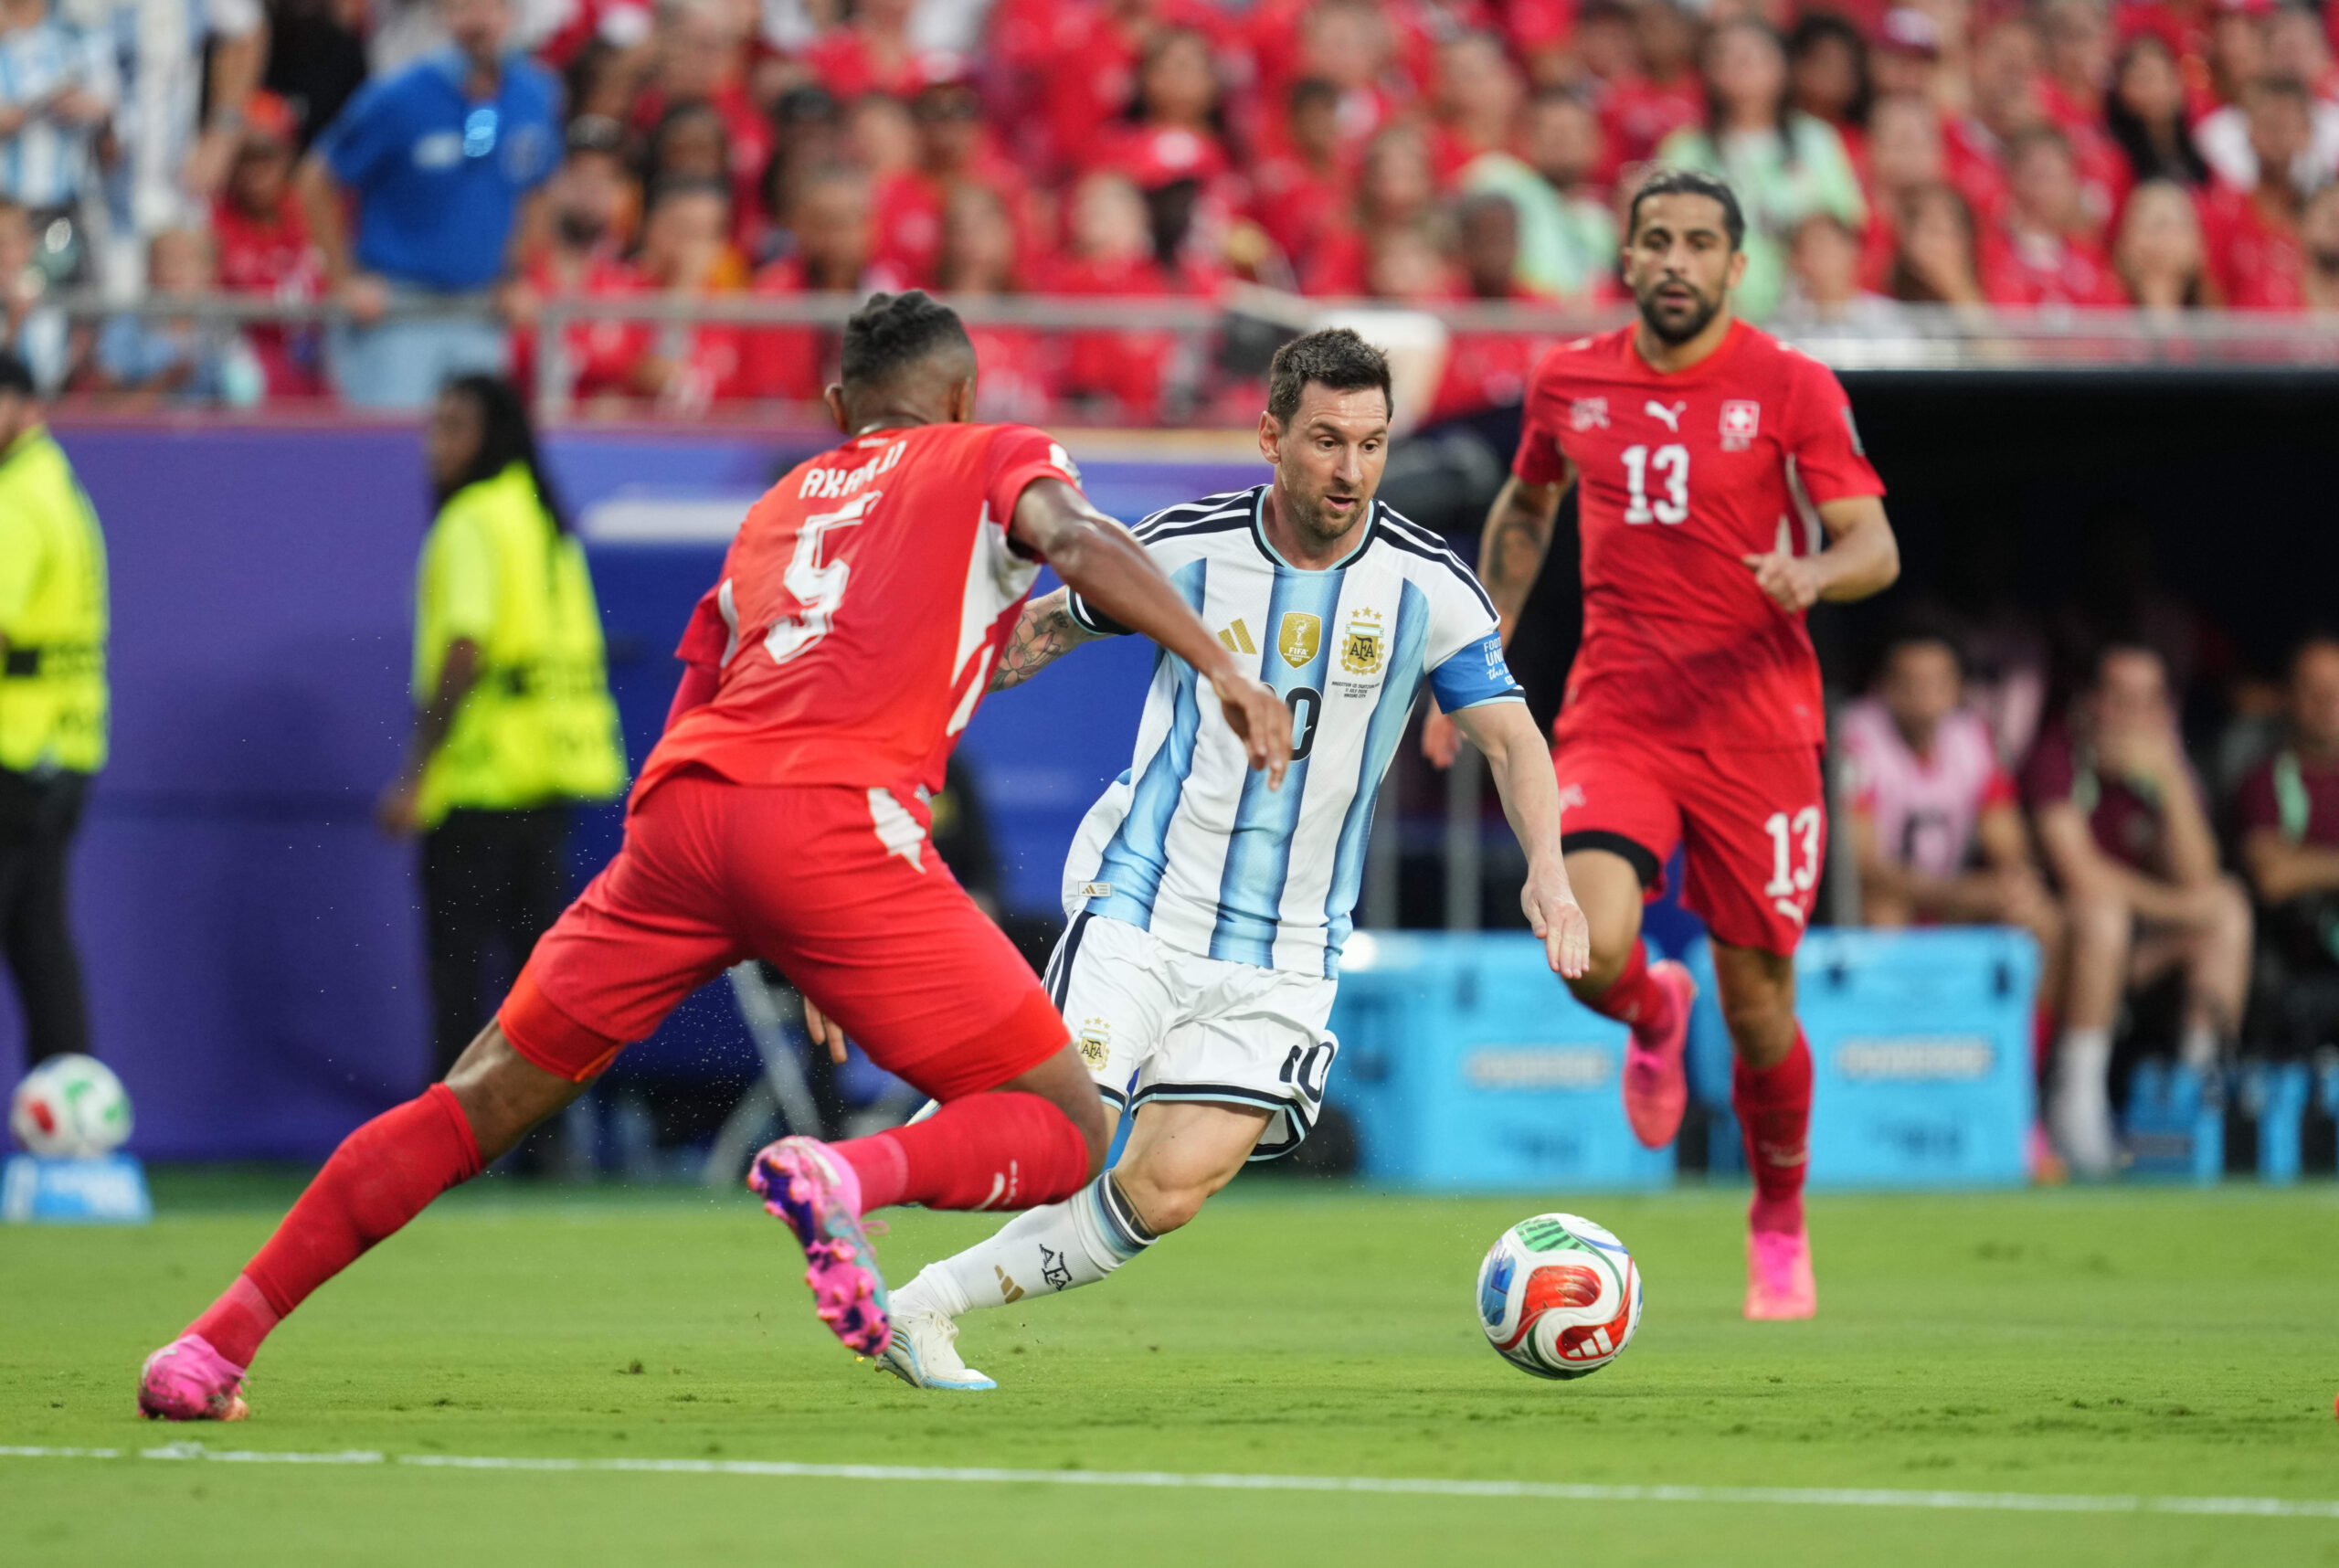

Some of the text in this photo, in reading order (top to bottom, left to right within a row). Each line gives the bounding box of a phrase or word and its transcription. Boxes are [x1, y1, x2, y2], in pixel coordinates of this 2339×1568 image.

[1621, 443, 1690, 525] 13
[763, 490, 884, 664] 5
[1289, 647, 1307, 656] FIFA
[1349, 635, 1375, 662] AFA
[1764, 806, 1819, 897] 13
[1081, 1036, 1104, 1060] AFA
[1039, 1243, 1073, 1292] AFA
